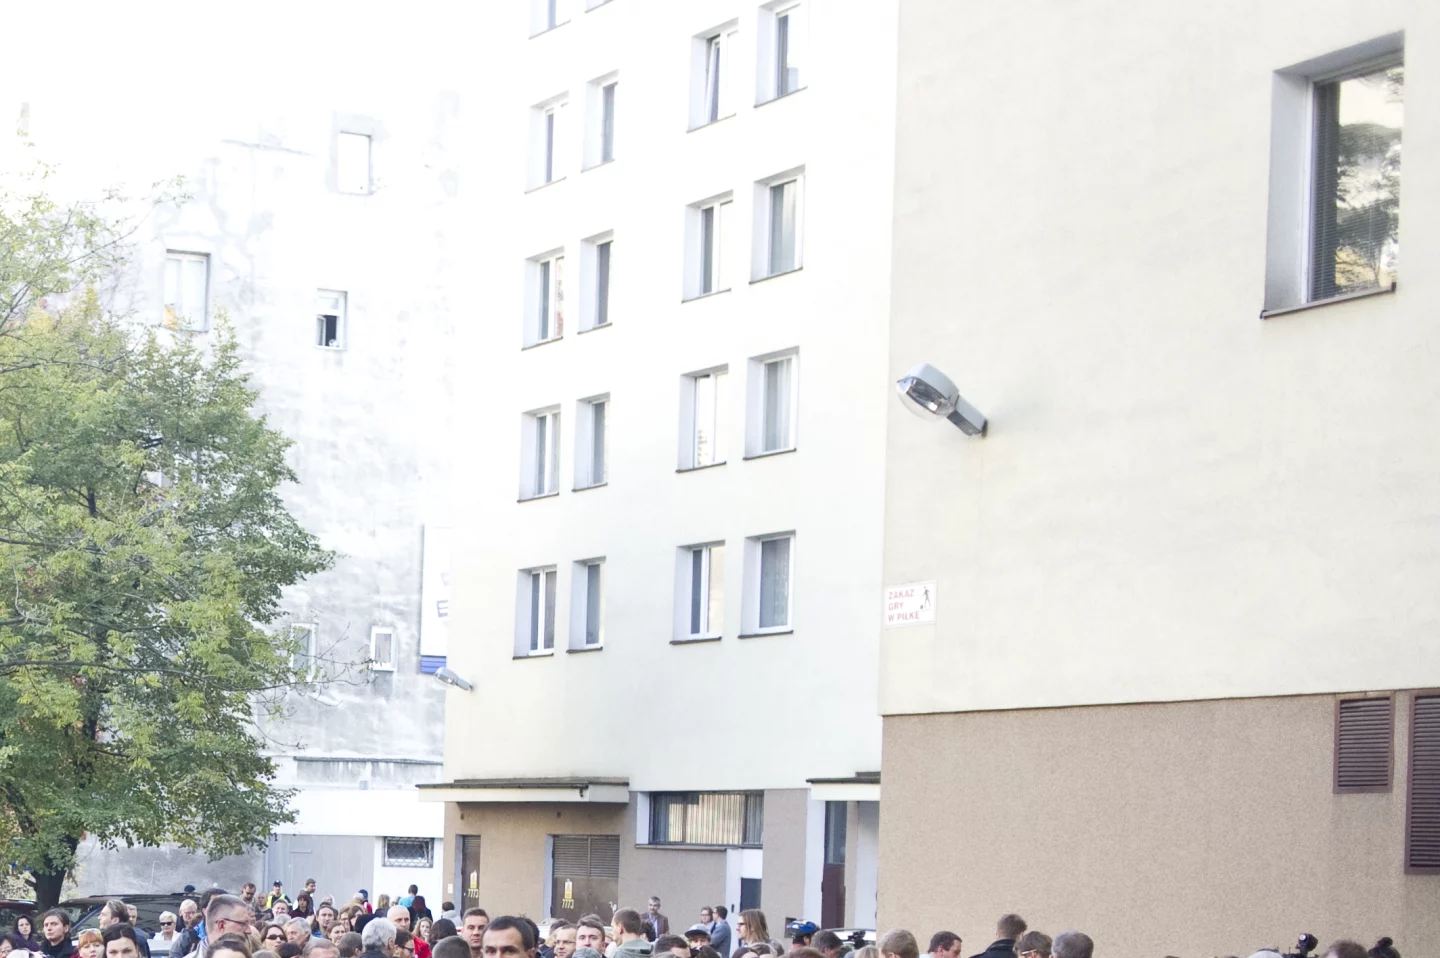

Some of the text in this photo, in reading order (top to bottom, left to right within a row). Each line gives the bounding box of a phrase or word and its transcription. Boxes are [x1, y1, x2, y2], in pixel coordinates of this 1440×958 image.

[888, 588, 915, 600] ZAKAZ
[888, 601, 904, 611] GRY
[888, 613, 895, 622] W
